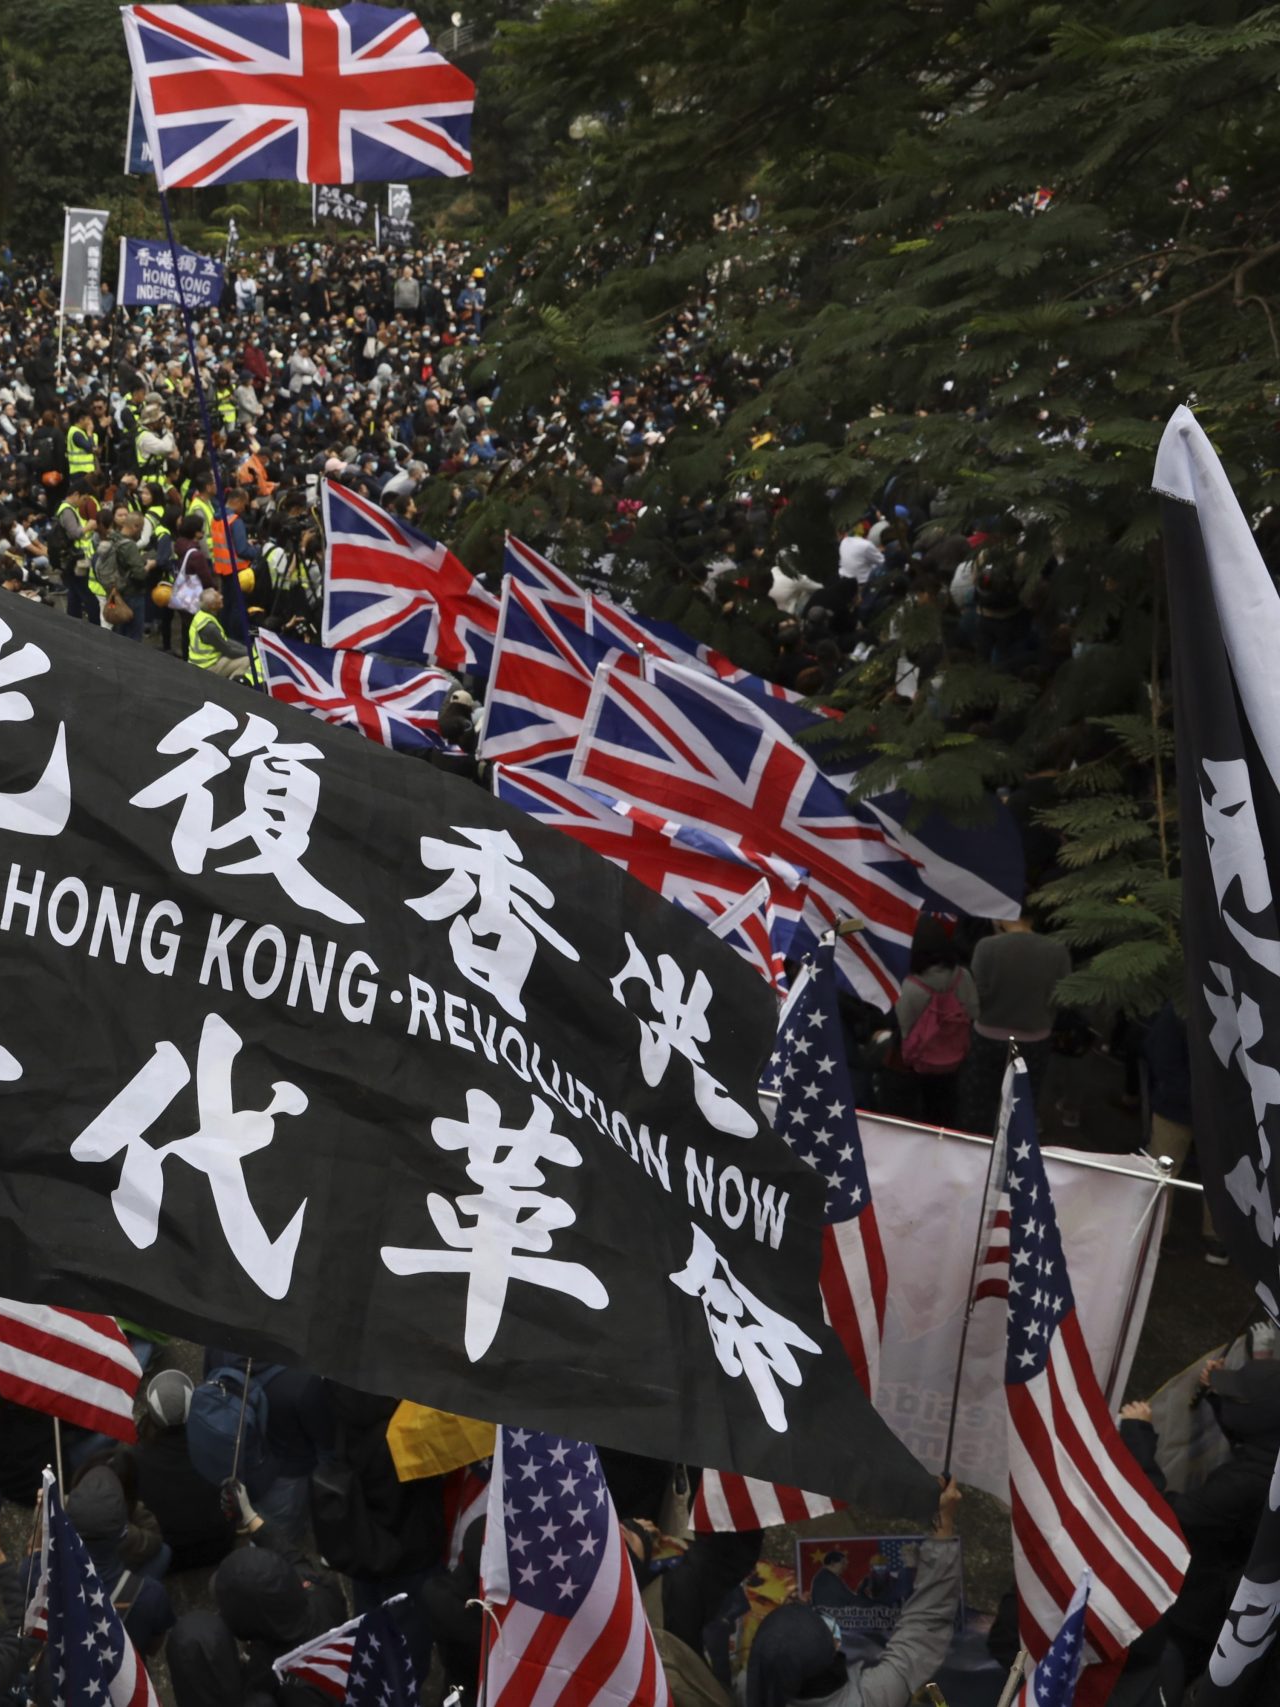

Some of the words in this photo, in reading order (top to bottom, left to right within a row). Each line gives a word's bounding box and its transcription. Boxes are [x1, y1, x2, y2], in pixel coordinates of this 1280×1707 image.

[142, 268, 176, 288] HONG
[0, 862, 185, 977] HONG
[684, 1146, 791, 1251] NOW
